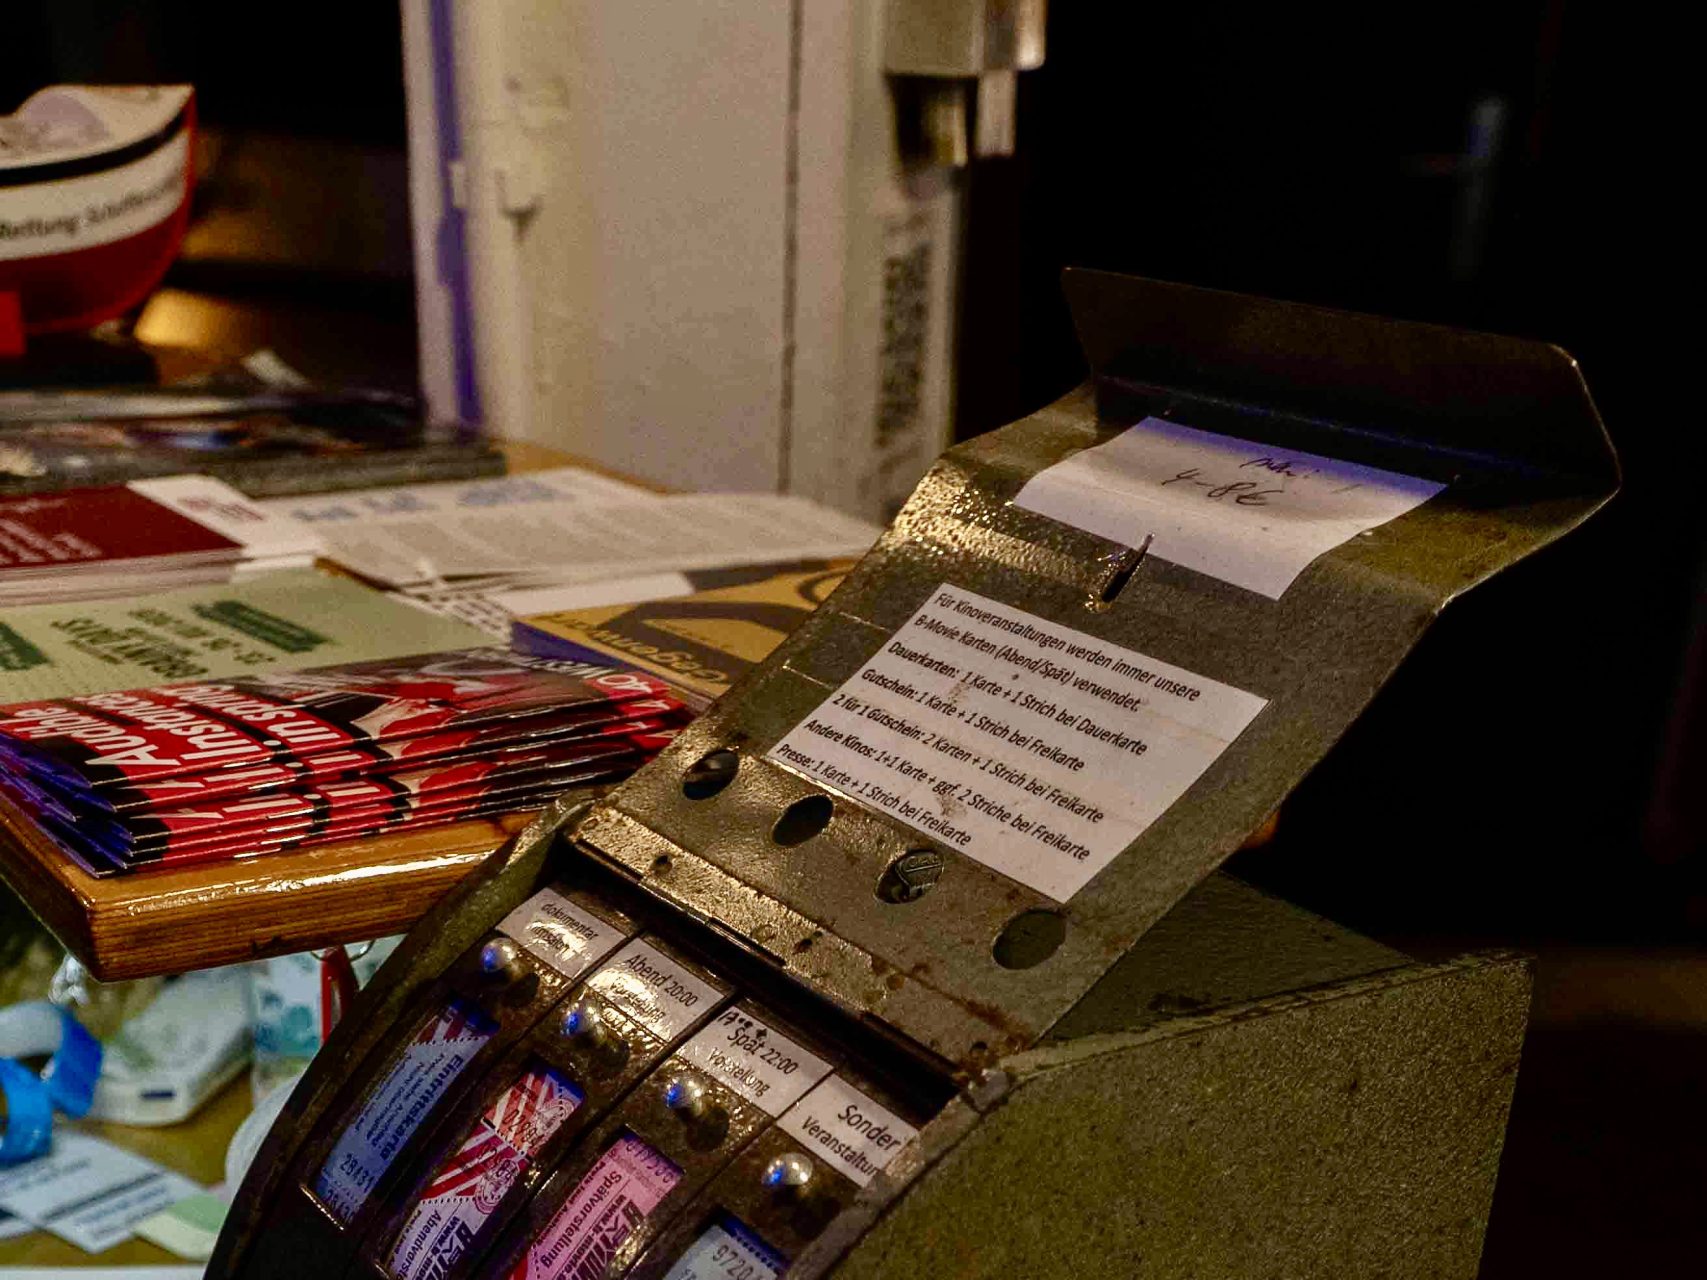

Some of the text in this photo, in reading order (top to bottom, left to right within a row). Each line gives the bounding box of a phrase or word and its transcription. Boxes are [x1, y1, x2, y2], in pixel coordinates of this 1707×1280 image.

[888, 641, 960, 679] Dauerkarten:
[969, 674, 1002, 696] Karte
[1020, 694, 1057, 718] Strich
[1055, 709, 1080, 728] bei
[1076, 718, 1148, 756] Dauerkarte
[914, 614, 1141, 712] B-Movie Karten (Abend/Spät) verwendet.
[934, 593, 1200, 702] Für Kinoveranstaltungen werden immer unsere
[843, 695, 860, 712] für
[867, 708, 924, 741] Gutschein:
[932, 737, 973, 763] Karten
[989, 763, 1026, 788] Strich
[1024, 780, 1050, 800] bei
[1046, 788, 1104, 824] Freikarte
[861, 668, 918, 699] Gutschein:
[924, 695, 957, 717] Karte
[973, 715, 1011, 740] Strich
[1008, 729, 1033, 748] bei
[1028, 739, 1085, 772] Freikarte
[776, 743, 815, 769] Presse:
[820, 764, 853, 786] Karte
[865, 786, 903, 810] Strich
[901, 801, 922, 820] bei
[917, 812, 973, 847] Freikarte
[804, 719, 844, 743] Andere
[840, 734, 875, 758] Kinos:
[873, 750, 898, 768] 1+1
[895, 760, 929, 782] Karte
[967, 794, 1012, 822] Striche
[1009, 814, 1035, 834] bei
[1031, 823, 1090, 861] Freikarte
[626, 954, 698, 1007] Abend 20:00
[377, 1052, 465, 1164] Eintrittskarte
[760, 1048, 799, 1076] 22:00
[838, 1104, 902, 1151] Sonder
[538, 1169, 623, 1270] Spätvorstellung
